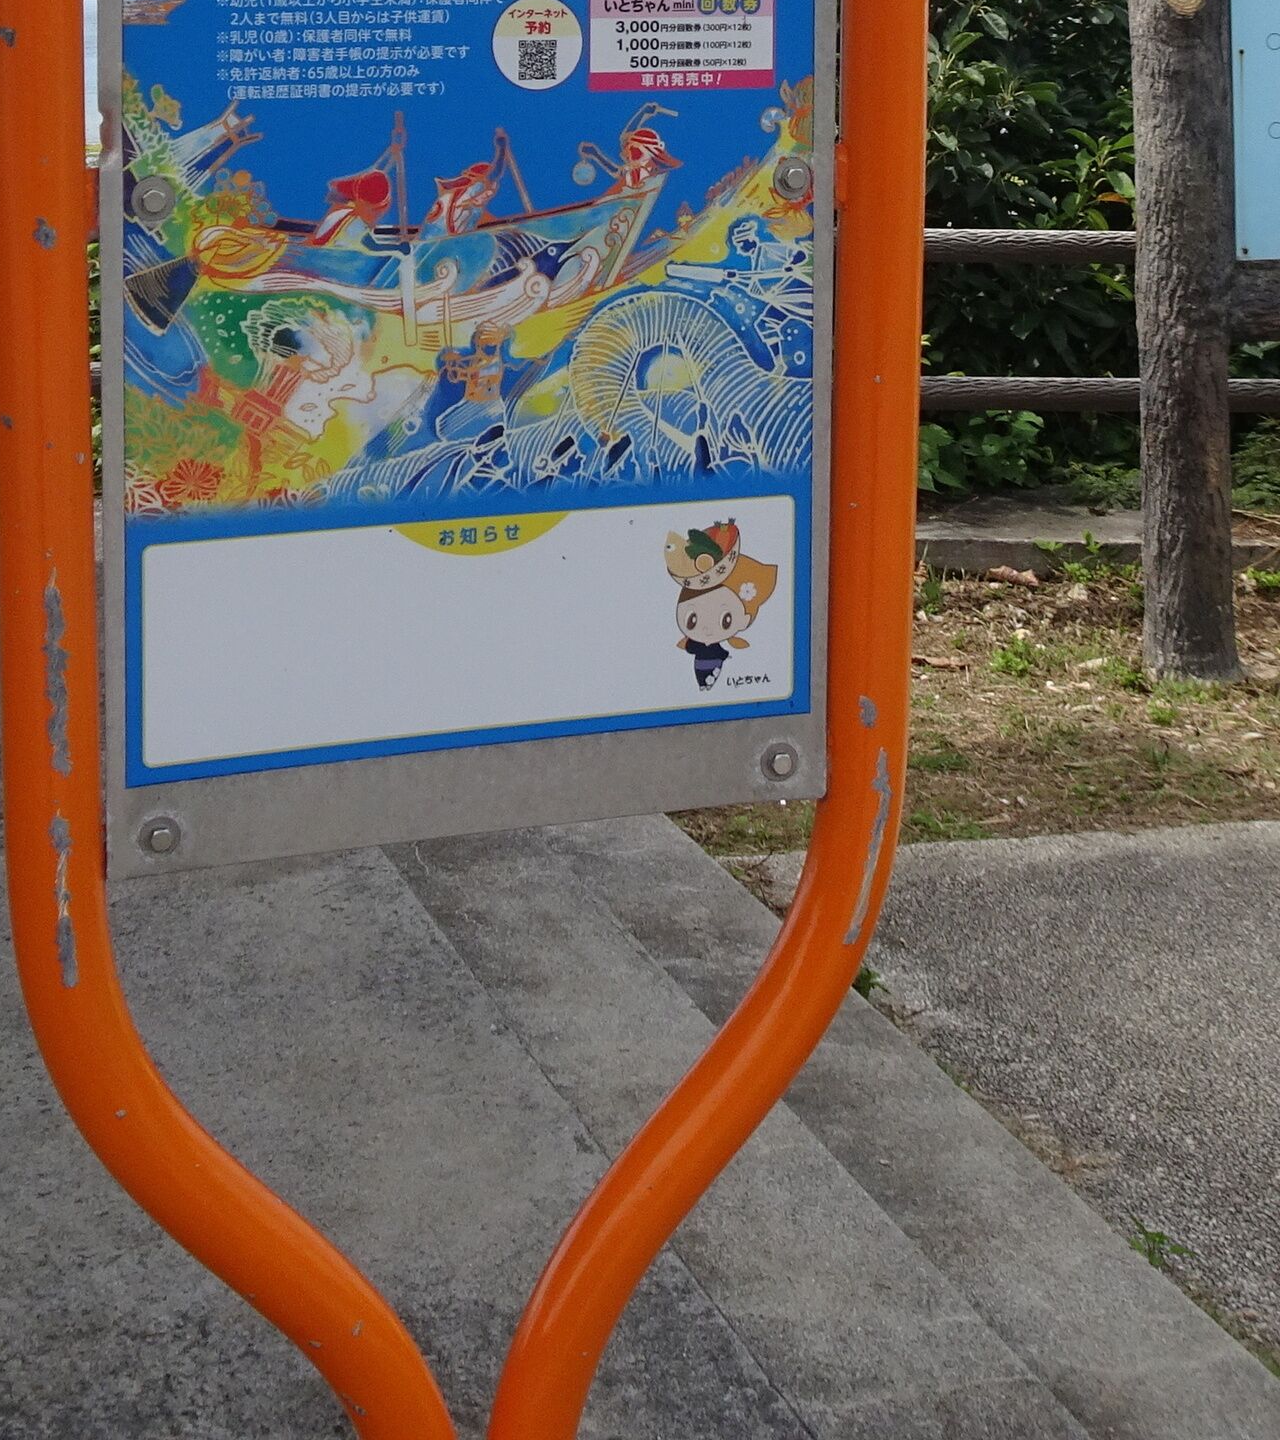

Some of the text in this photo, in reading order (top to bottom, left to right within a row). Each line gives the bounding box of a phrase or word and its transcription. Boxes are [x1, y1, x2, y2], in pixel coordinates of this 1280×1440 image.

[508, 8, 568, 19] インターネット
[604, 0, 670, 13] いとちゃん
[673, 0, 695, 9] mini
[524, 21, 551, 35] 予約
[438, 524, 521, 547] お知らせ
[726, 673, 771, 688] いとちゃん
